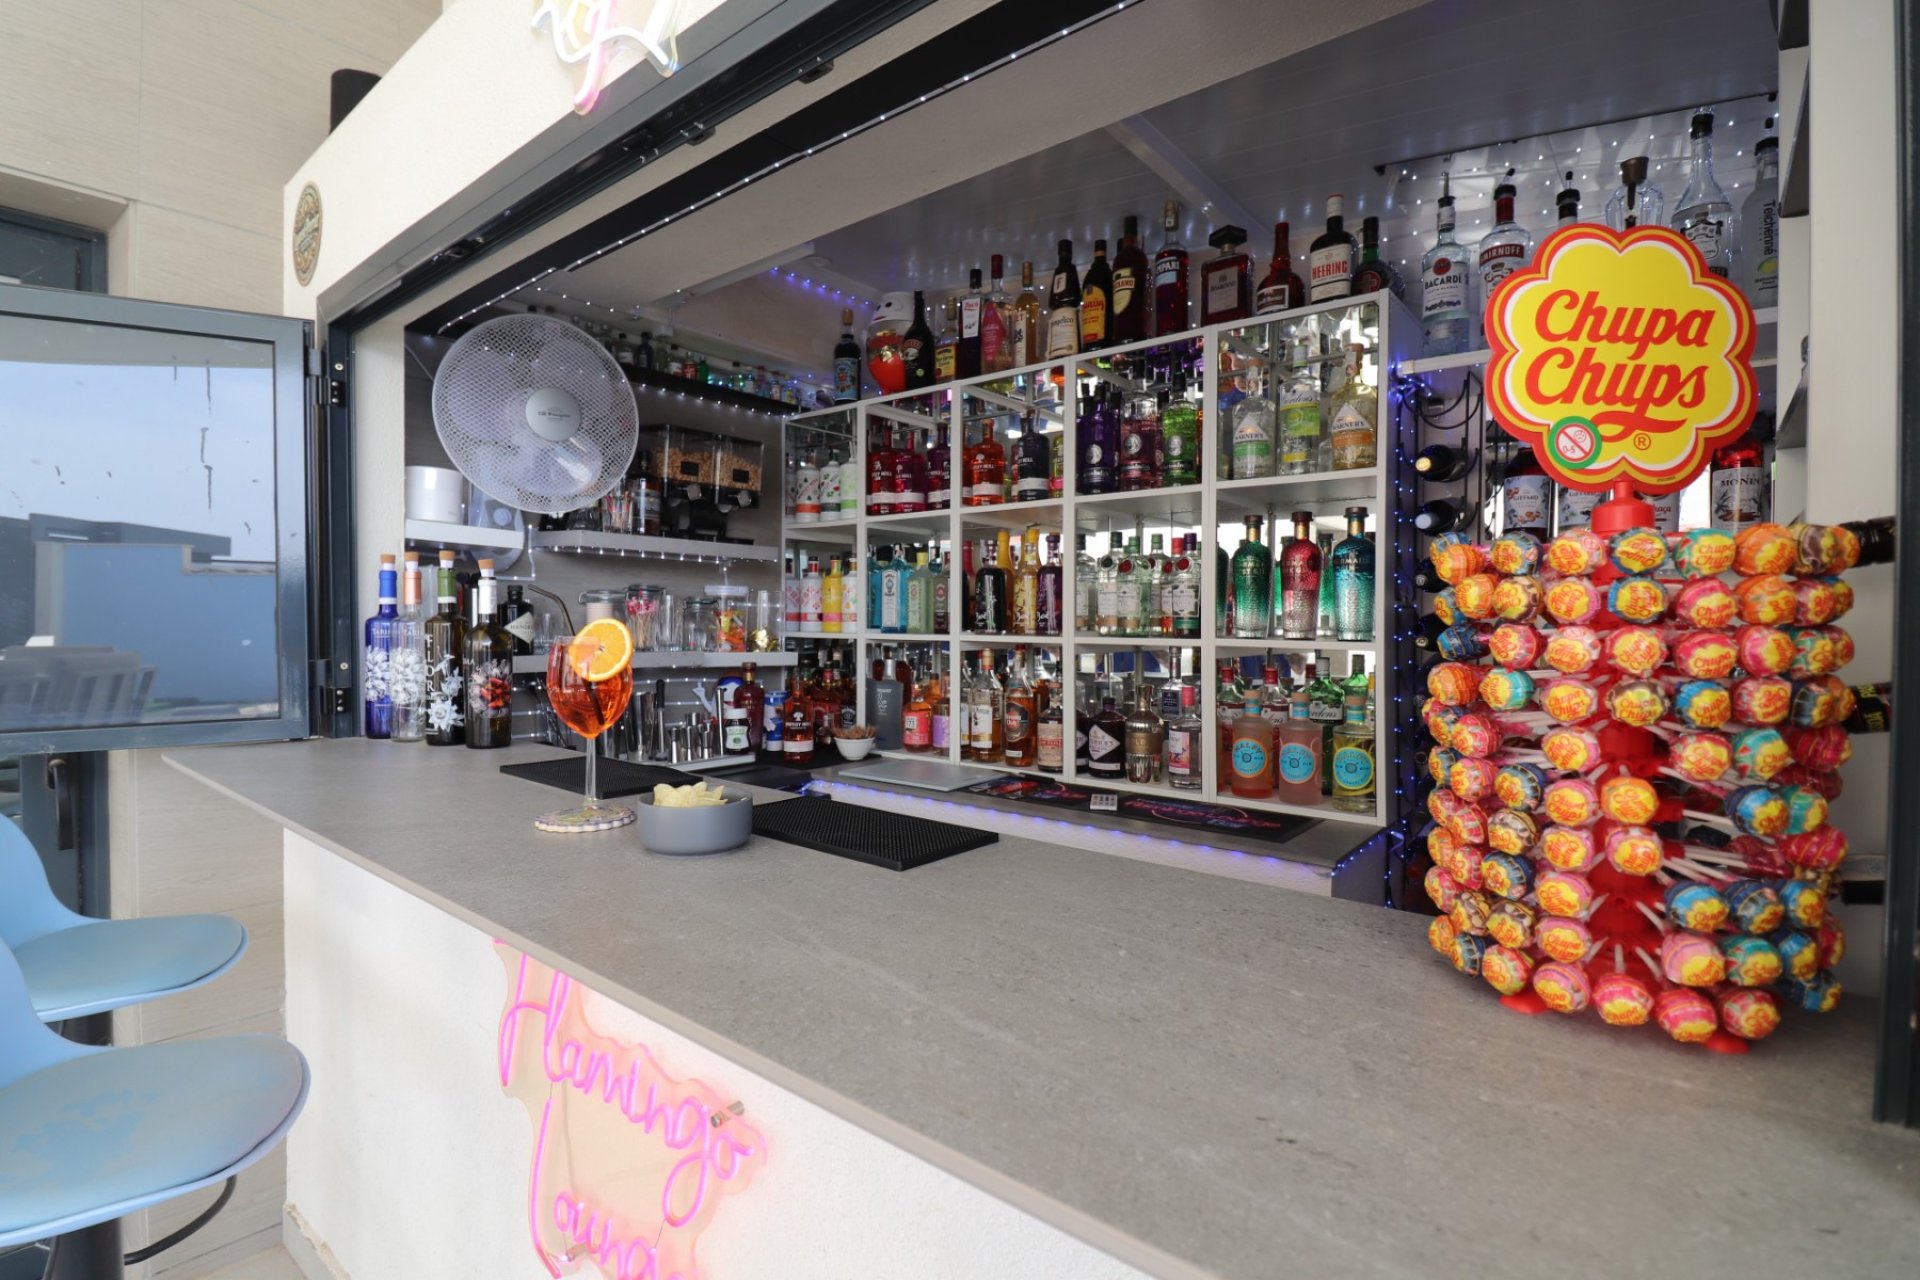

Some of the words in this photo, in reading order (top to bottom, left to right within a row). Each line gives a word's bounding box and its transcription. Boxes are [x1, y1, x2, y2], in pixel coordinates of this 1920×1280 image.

[1311, 260, 1348, 280] HEERING
[1425, 274, 1462, 290] BACARDÍ
[1535, 289, 1716, 360] Chupa
[1525, 347, 1710, 443] Chups
[1720, 477, 1761, 488] MONIN
